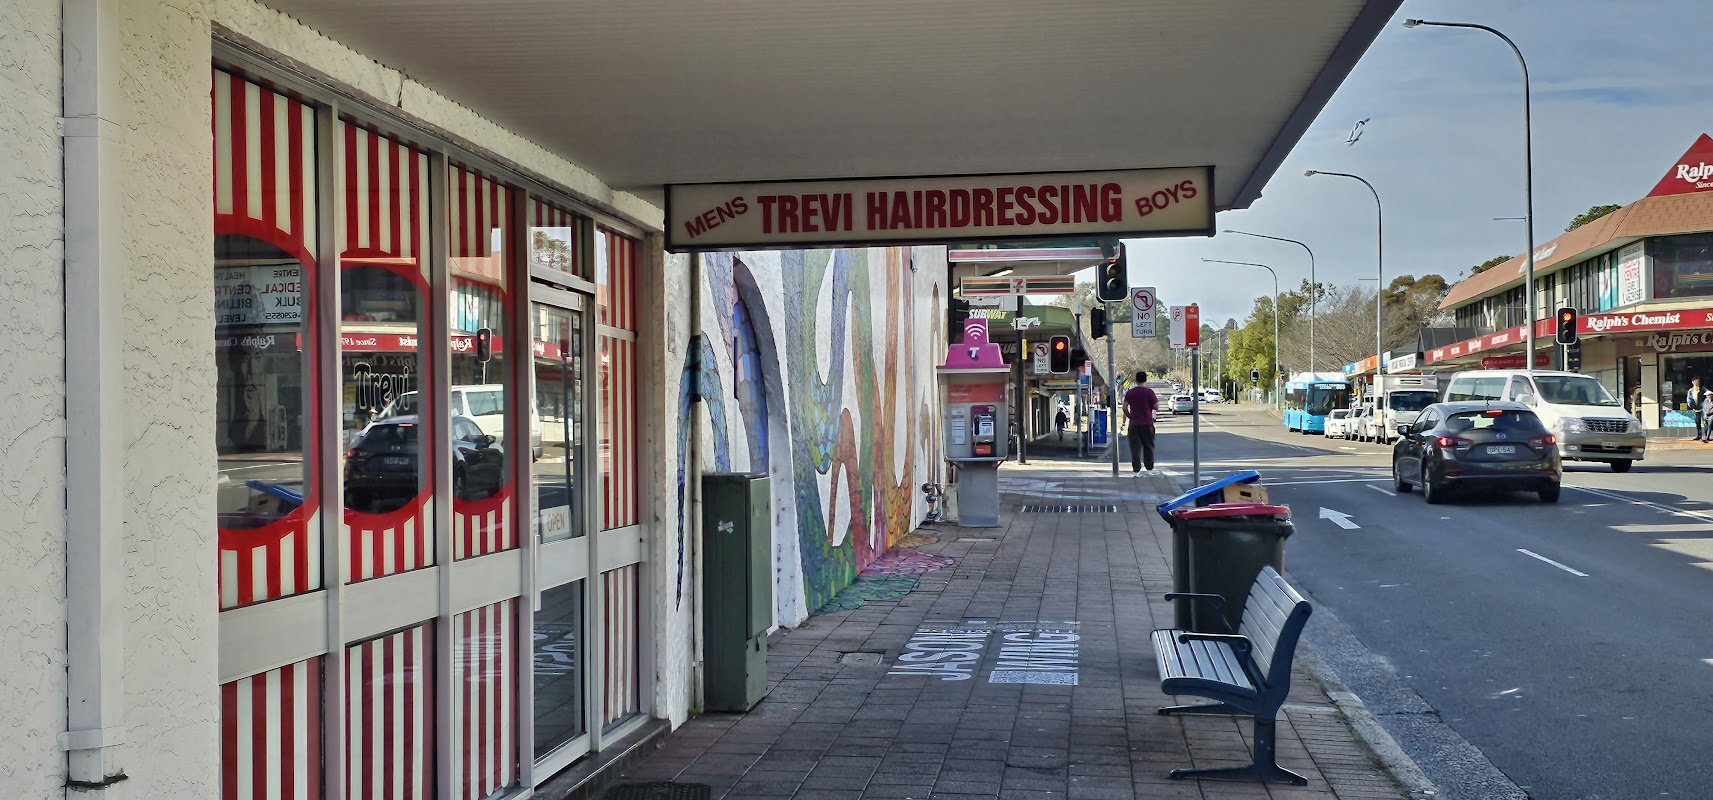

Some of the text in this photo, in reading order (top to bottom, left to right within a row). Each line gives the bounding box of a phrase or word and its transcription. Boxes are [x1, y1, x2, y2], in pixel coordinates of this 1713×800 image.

[684, 179, 1197, 238] MENS TREVI HAIRDRESSING BOYS
[968, 309, 1007, 320] SUBWAY
[1586, 316, 1629, 331] Ralph's
[1631, 312, 1680, 326] Chemist
[1646, 332, 1699, 352] Ralph's
[354, 362, 410, 410] Trevi
[548, 512, 565, 533] OPEN
